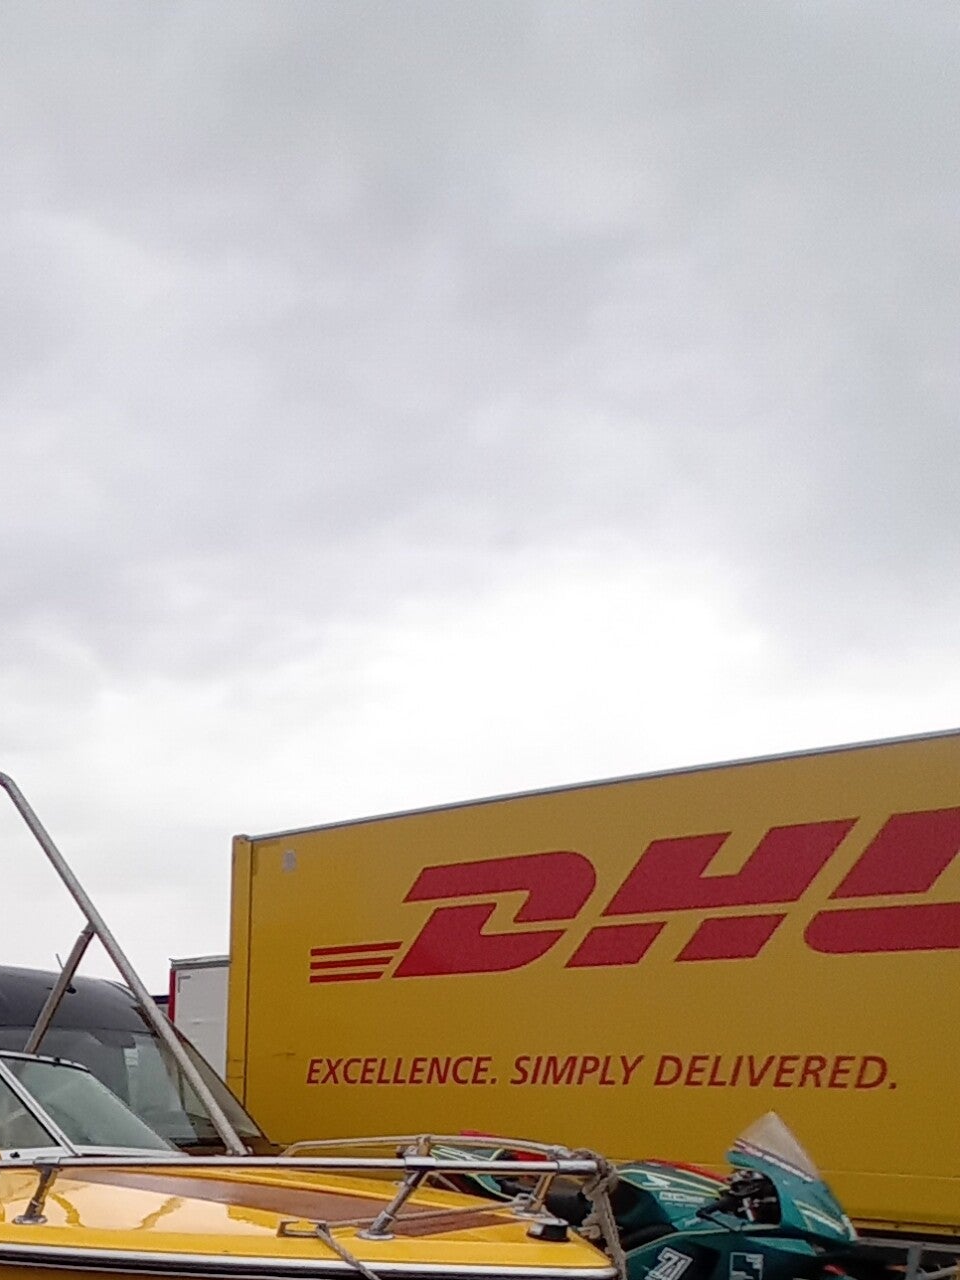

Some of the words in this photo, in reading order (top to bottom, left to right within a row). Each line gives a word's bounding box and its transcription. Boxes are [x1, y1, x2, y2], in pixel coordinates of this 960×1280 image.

[306, 1056, 497, 1085] EXCELLENCE.
[510, 1055, 645, 1086] SIMPLY
[653, 1055, 897, 1090] DELIVERED.
